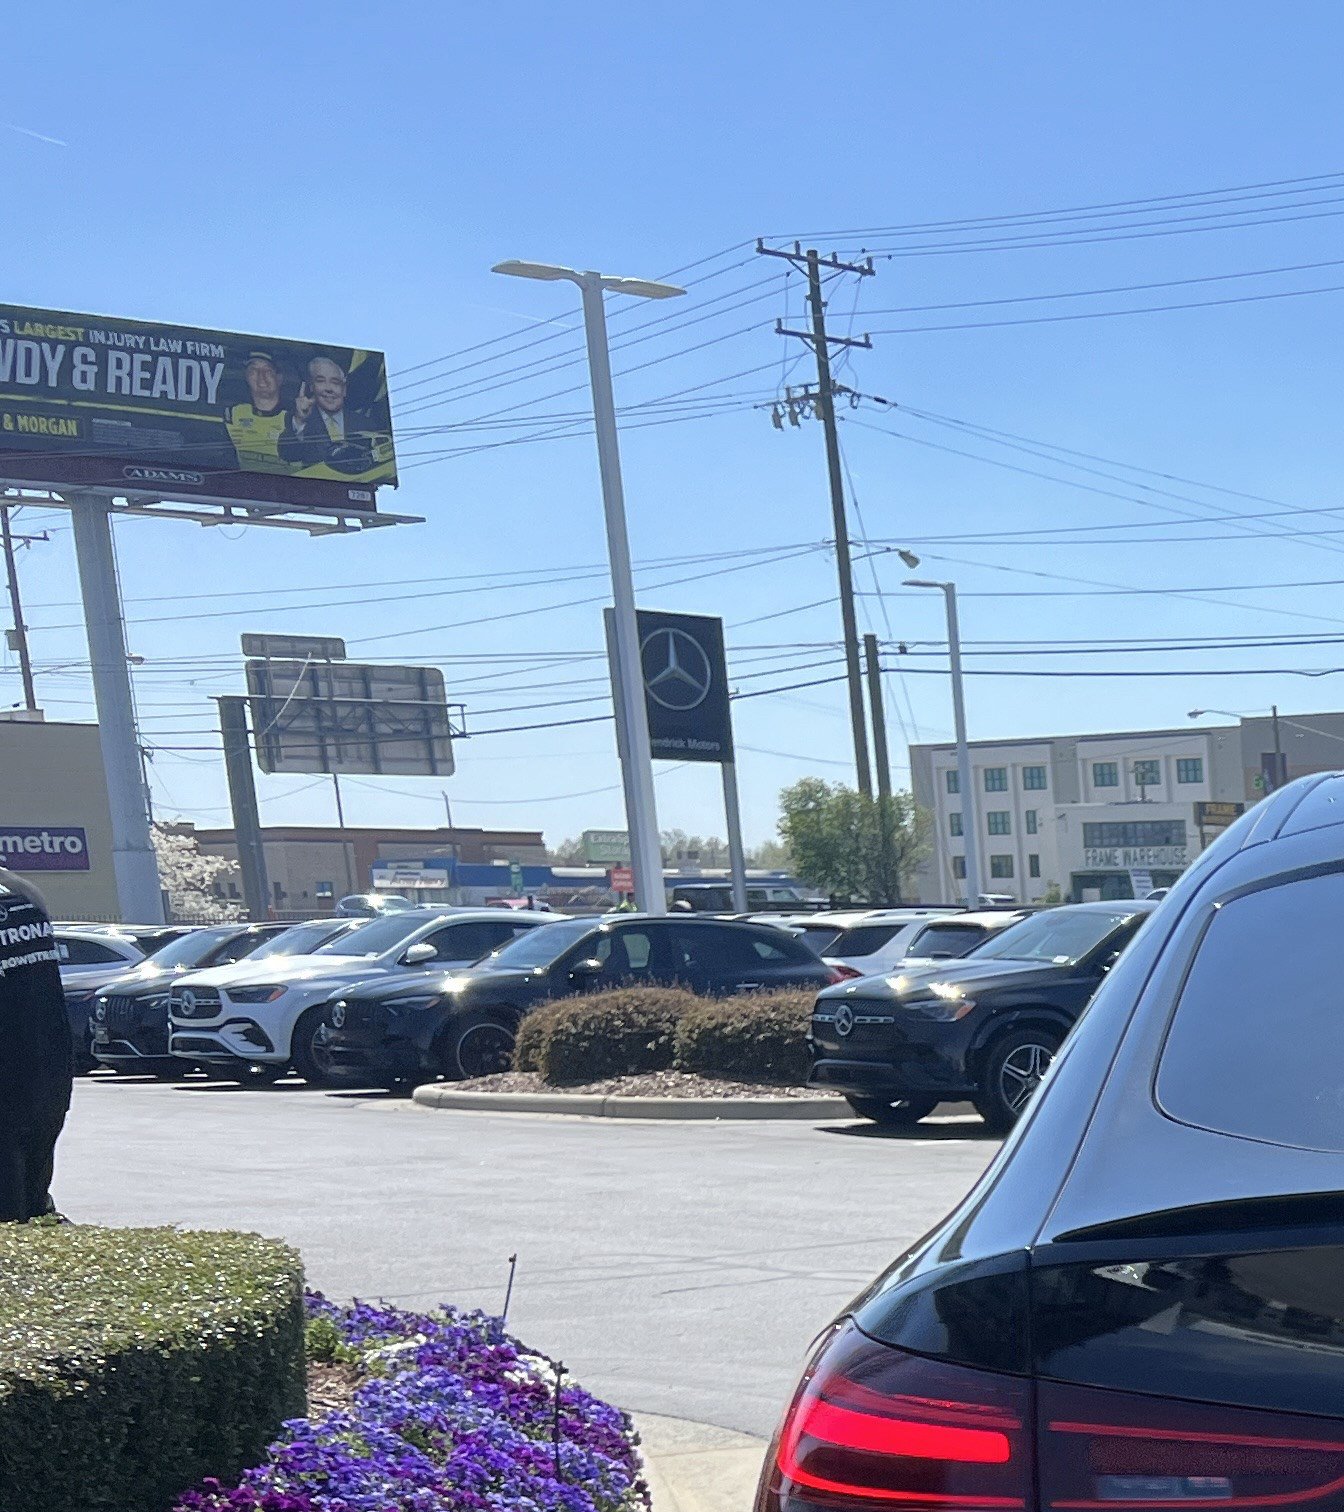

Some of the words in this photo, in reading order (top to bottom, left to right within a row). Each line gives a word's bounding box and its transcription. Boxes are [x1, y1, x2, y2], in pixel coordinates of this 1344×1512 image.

[14, 320, 84, 342] LARGEST
[88, 329, 146, 350] INJURY
[150, 336, 183, 353] LAW
[185, 341, 225, 358] FIRM
[72, 346, 98, 392] &
[106, 350, 225, 404] READY
[3, 413, 14, 431] &
[16, 414, 78, 437] MORGAN
[0, 832, 83, 854] metro
[1085, 848, 1119, 868] FRAME
[1122, 846, 1187, 867] WAREHOUSE
[0, 921, 54, 946] TRONA
